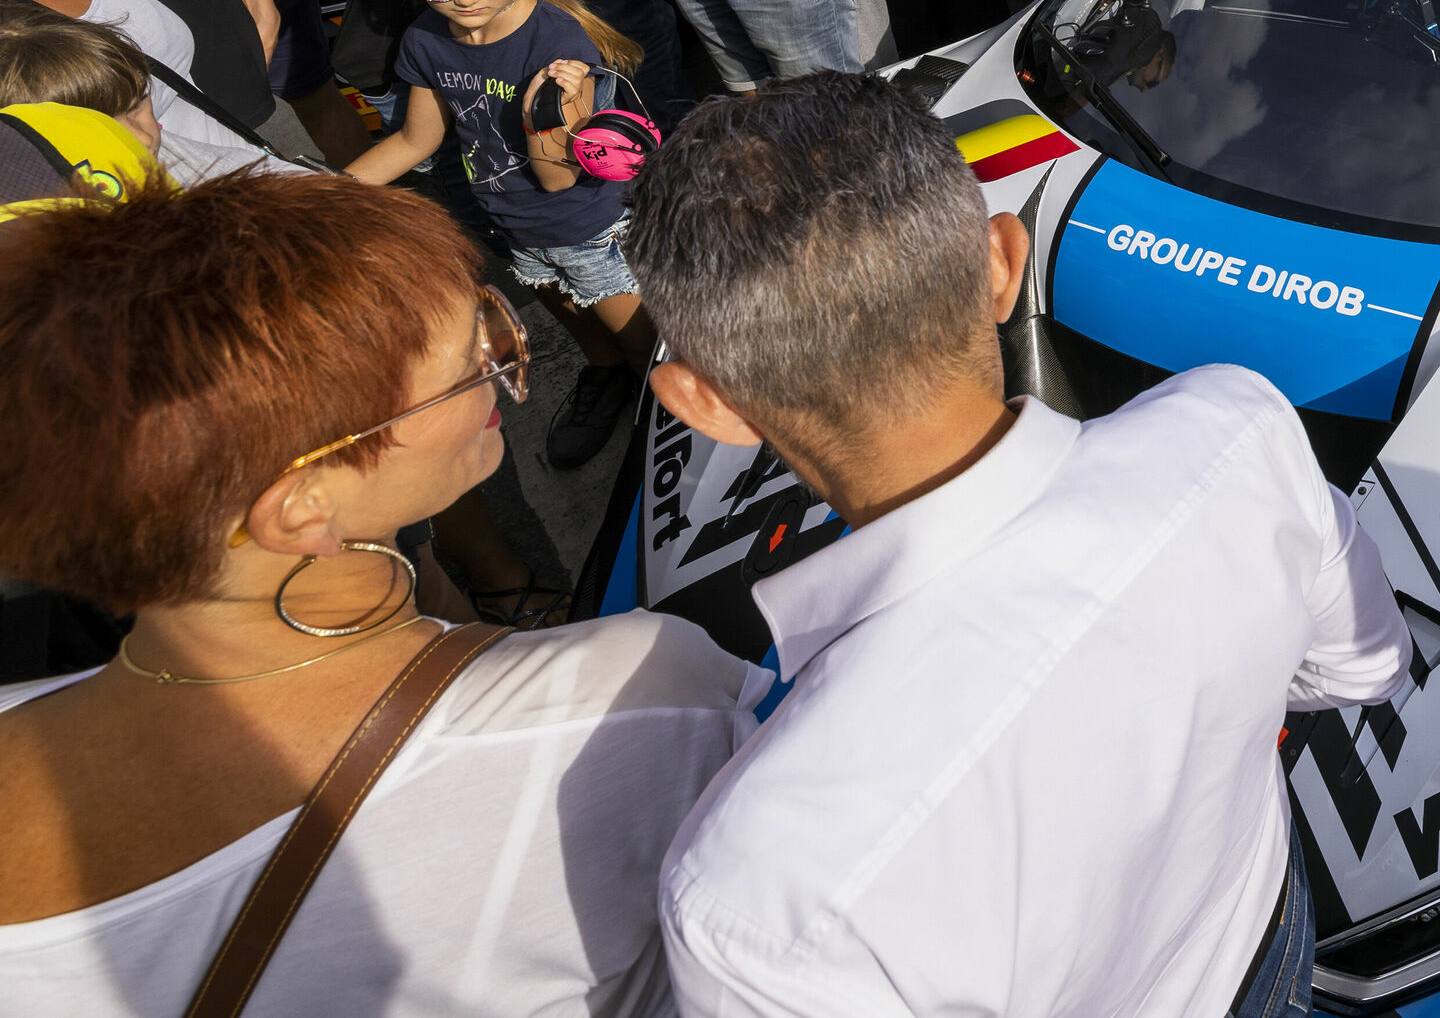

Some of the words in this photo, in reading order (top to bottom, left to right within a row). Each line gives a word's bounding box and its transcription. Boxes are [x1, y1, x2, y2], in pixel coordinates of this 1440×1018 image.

[437, 71, 481, 91] LEMON
[583, 147, 607, 161] kid
[1106, 224, 1247, 286] GROUPE
[1247, 264, 1365, 317] DIROB
